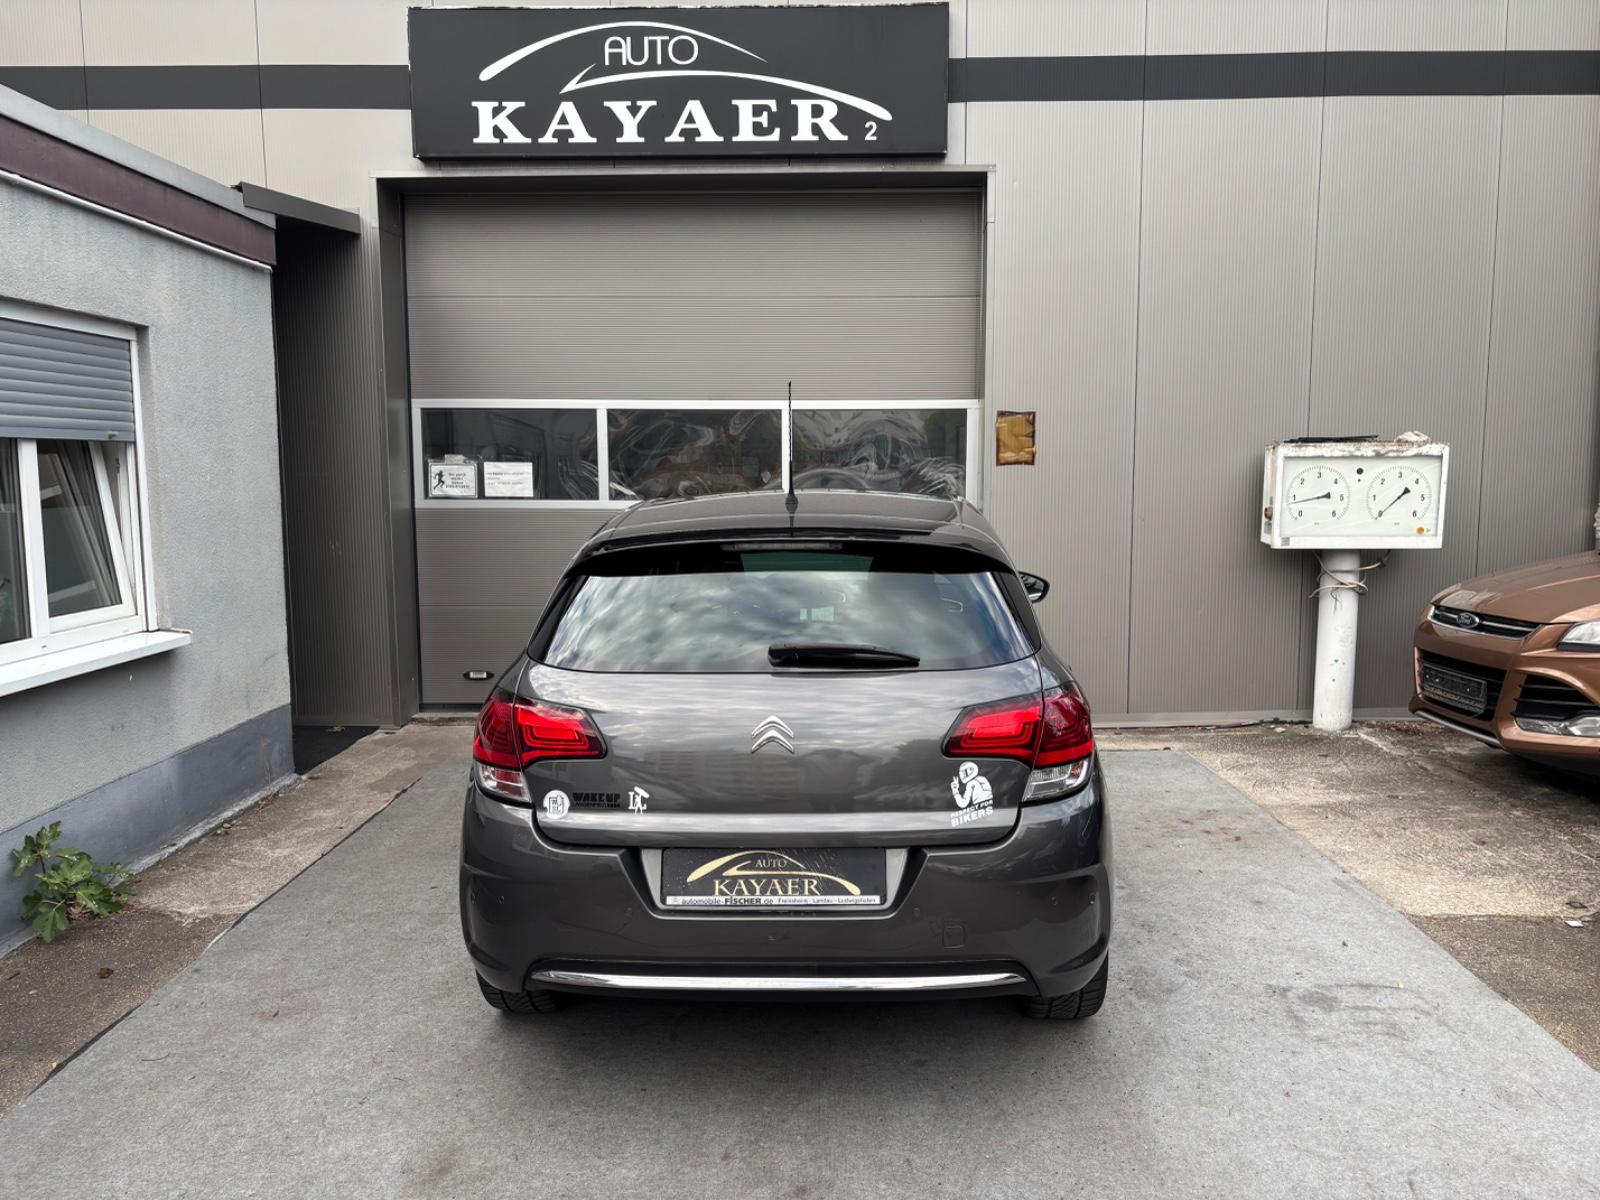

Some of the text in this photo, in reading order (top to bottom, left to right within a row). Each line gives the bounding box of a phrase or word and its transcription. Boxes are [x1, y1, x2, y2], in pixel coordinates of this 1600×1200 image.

[603, 35, 699, 66] AUTO
[471, 99, 878, 144] KAYAER 2
[574, 792, 621, 803] WAKE UP
[951, 806, 993, 827] BIKERS
[755, 859, 787, 868] AUTO
[713, 878, 820, 896] KAYAER
